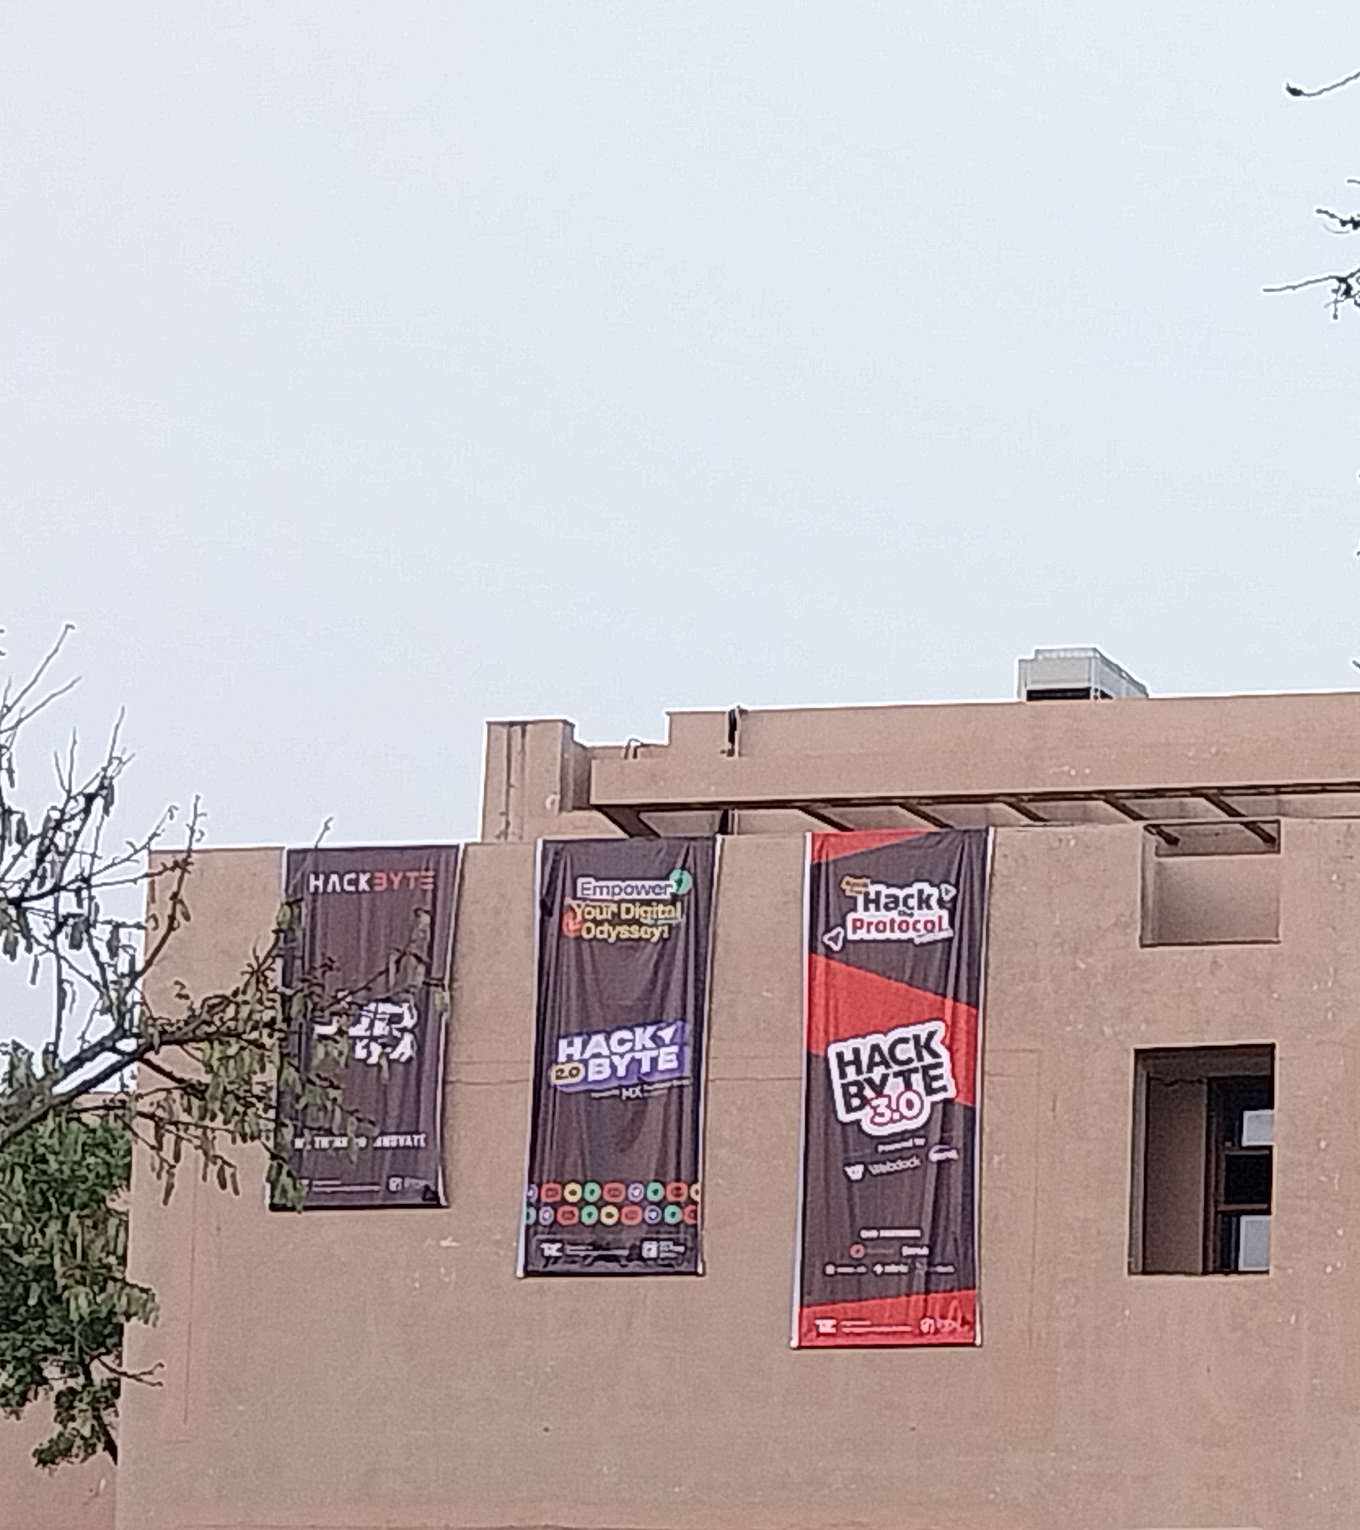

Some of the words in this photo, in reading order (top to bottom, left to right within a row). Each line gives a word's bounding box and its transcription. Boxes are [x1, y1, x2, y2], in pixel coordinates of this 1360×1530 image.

[580, 880, 674, 898] Empower
[863, 888, 935, 912] Hack
[571, 902, 618, 920] Your
[620, 901, 682, 925] Digital
[851, 914, 943, 935] Protocol
[557, 1025, 659, 1062] HACK
[835, 1029, 942, 1080] HACK
[587, 1045, 679, 1082] BYTE
[841, 1061, 949, 1115] BYTE
[870, 1089, 924, 1126] 3.0
